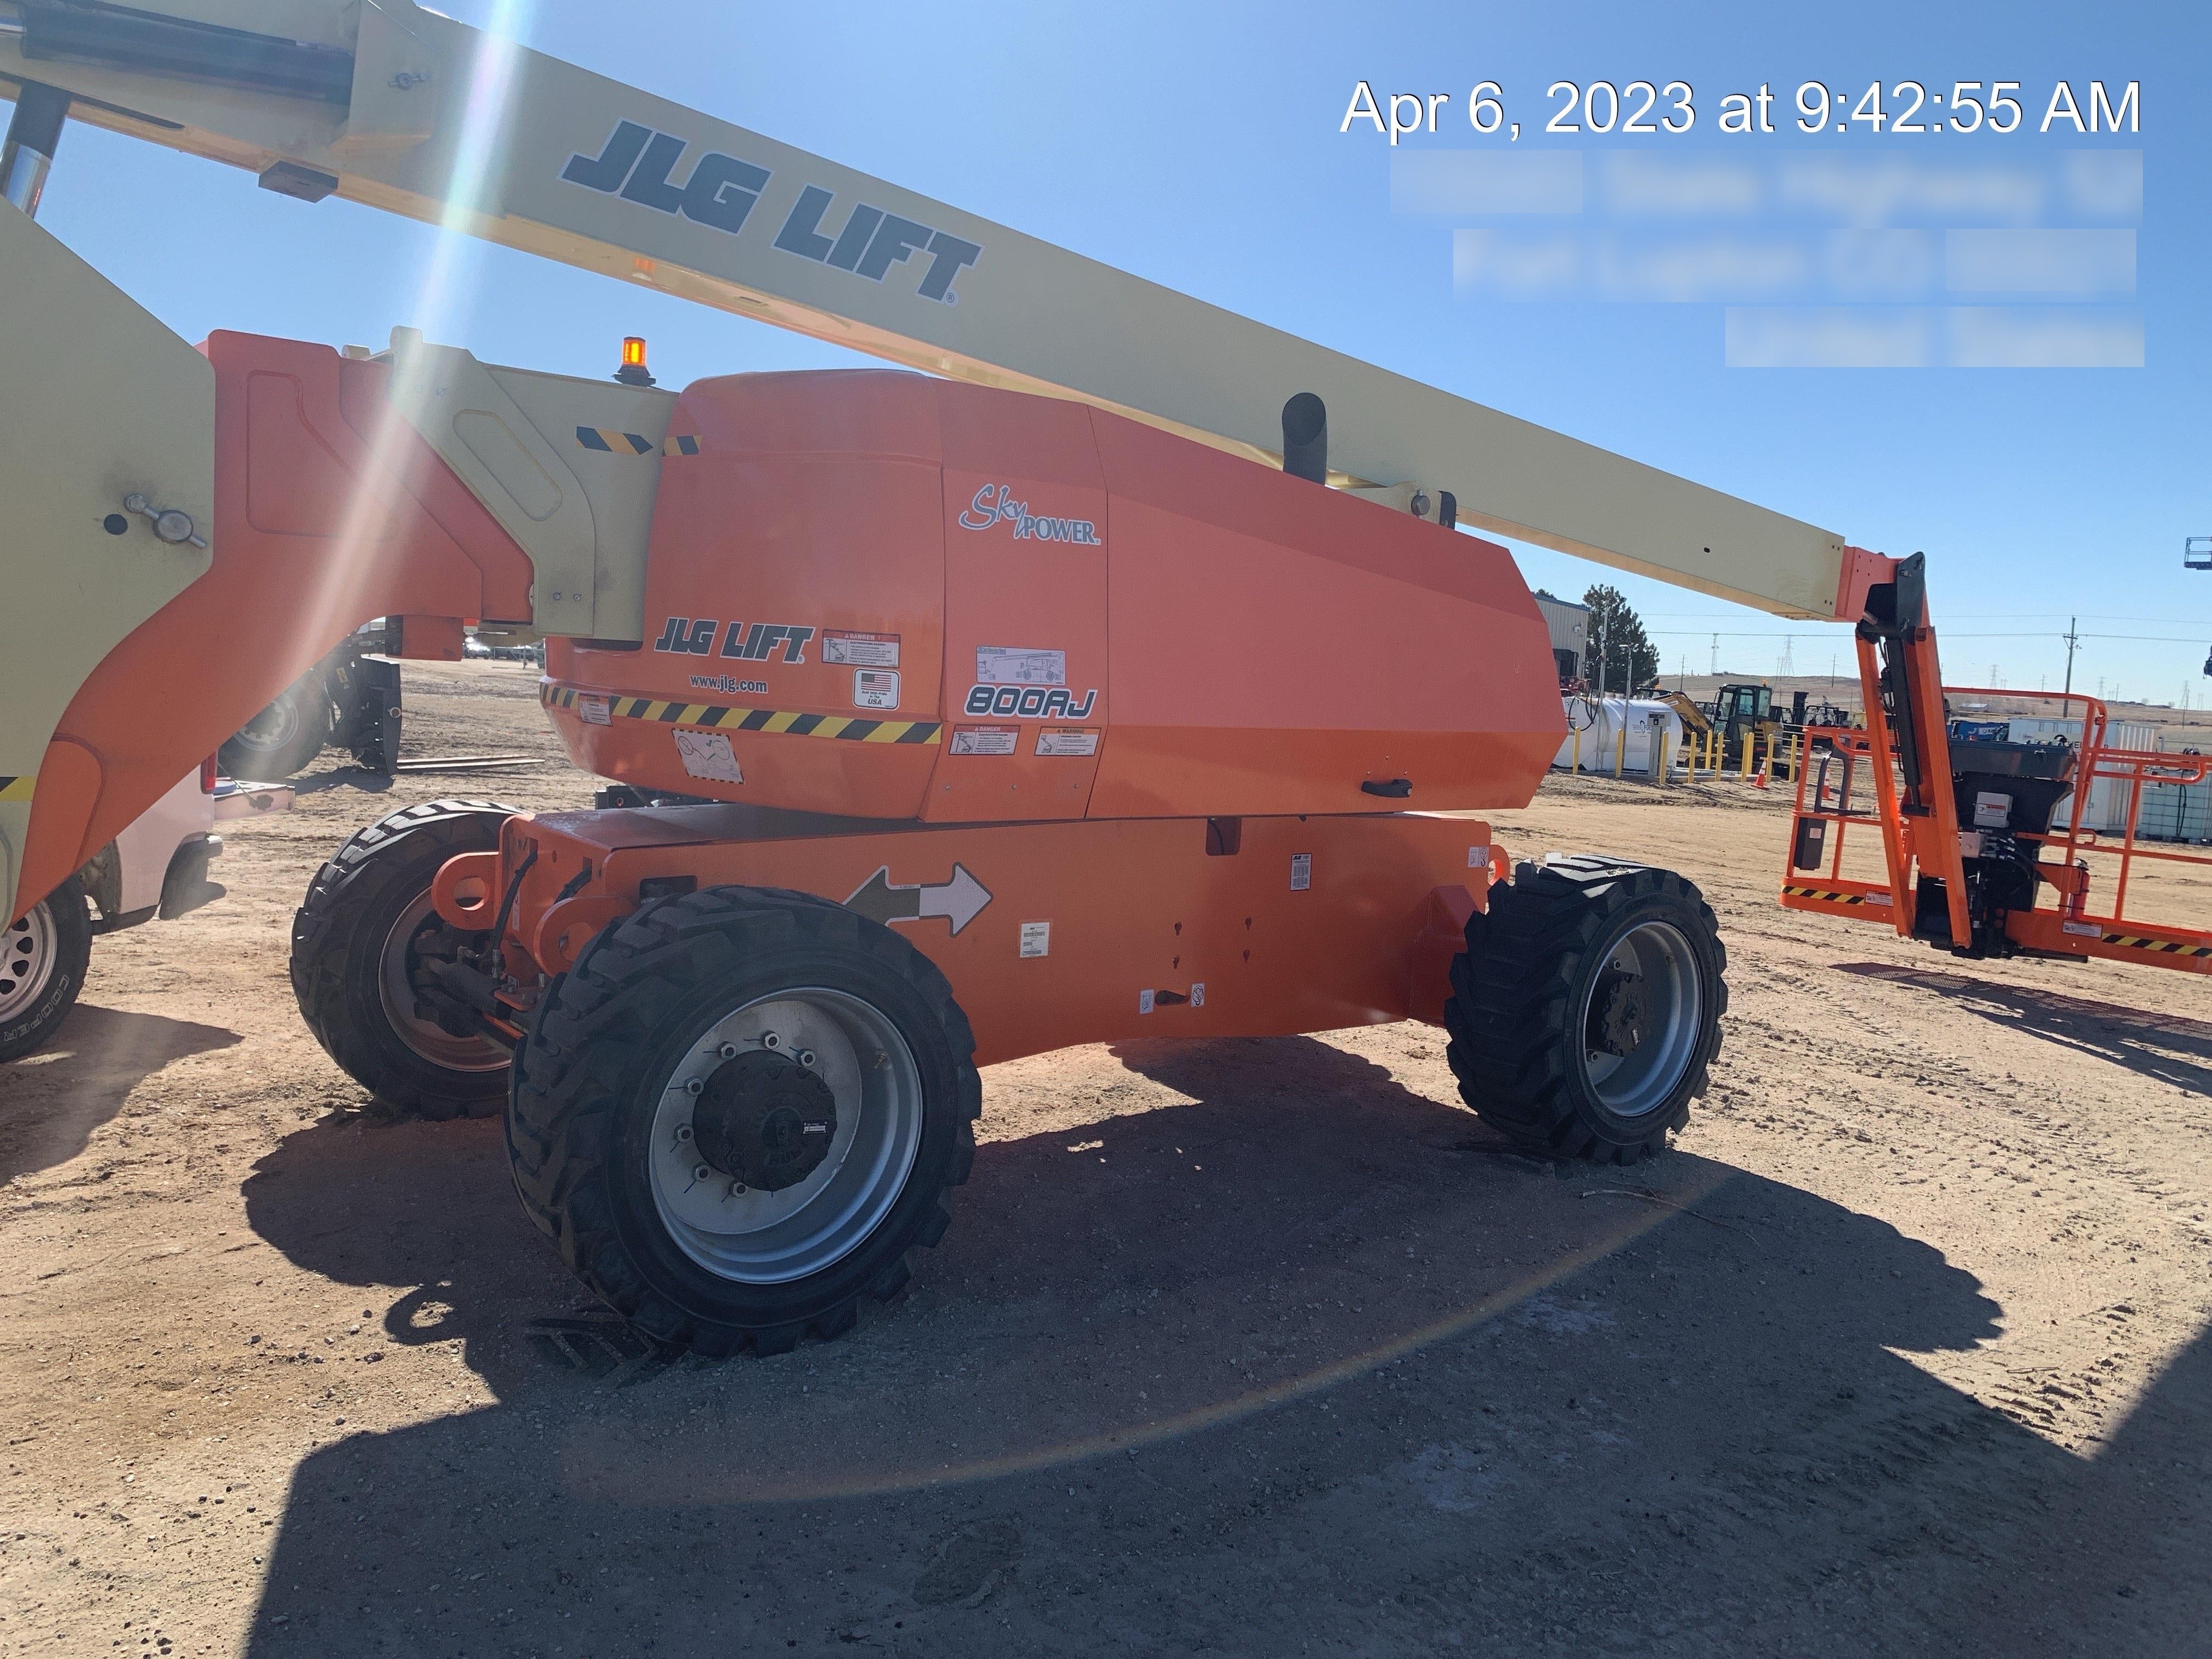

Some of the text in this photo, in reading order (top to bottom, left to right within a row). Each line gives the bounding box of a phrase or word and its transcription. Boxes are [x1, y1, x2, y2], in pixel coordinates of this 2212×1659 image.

[557, 117, 986, 303] JLG LIFT
[1023, 516, 1096, 544] POWER
[654, 617, 719, 656] JLG
[720, 622, 816, 664] LIFT
[690, 675, 768, 693] www.jlg.com
[964, 685, 1098, 719] 800AJ
[4, 974, 70, 1041] COOPER
